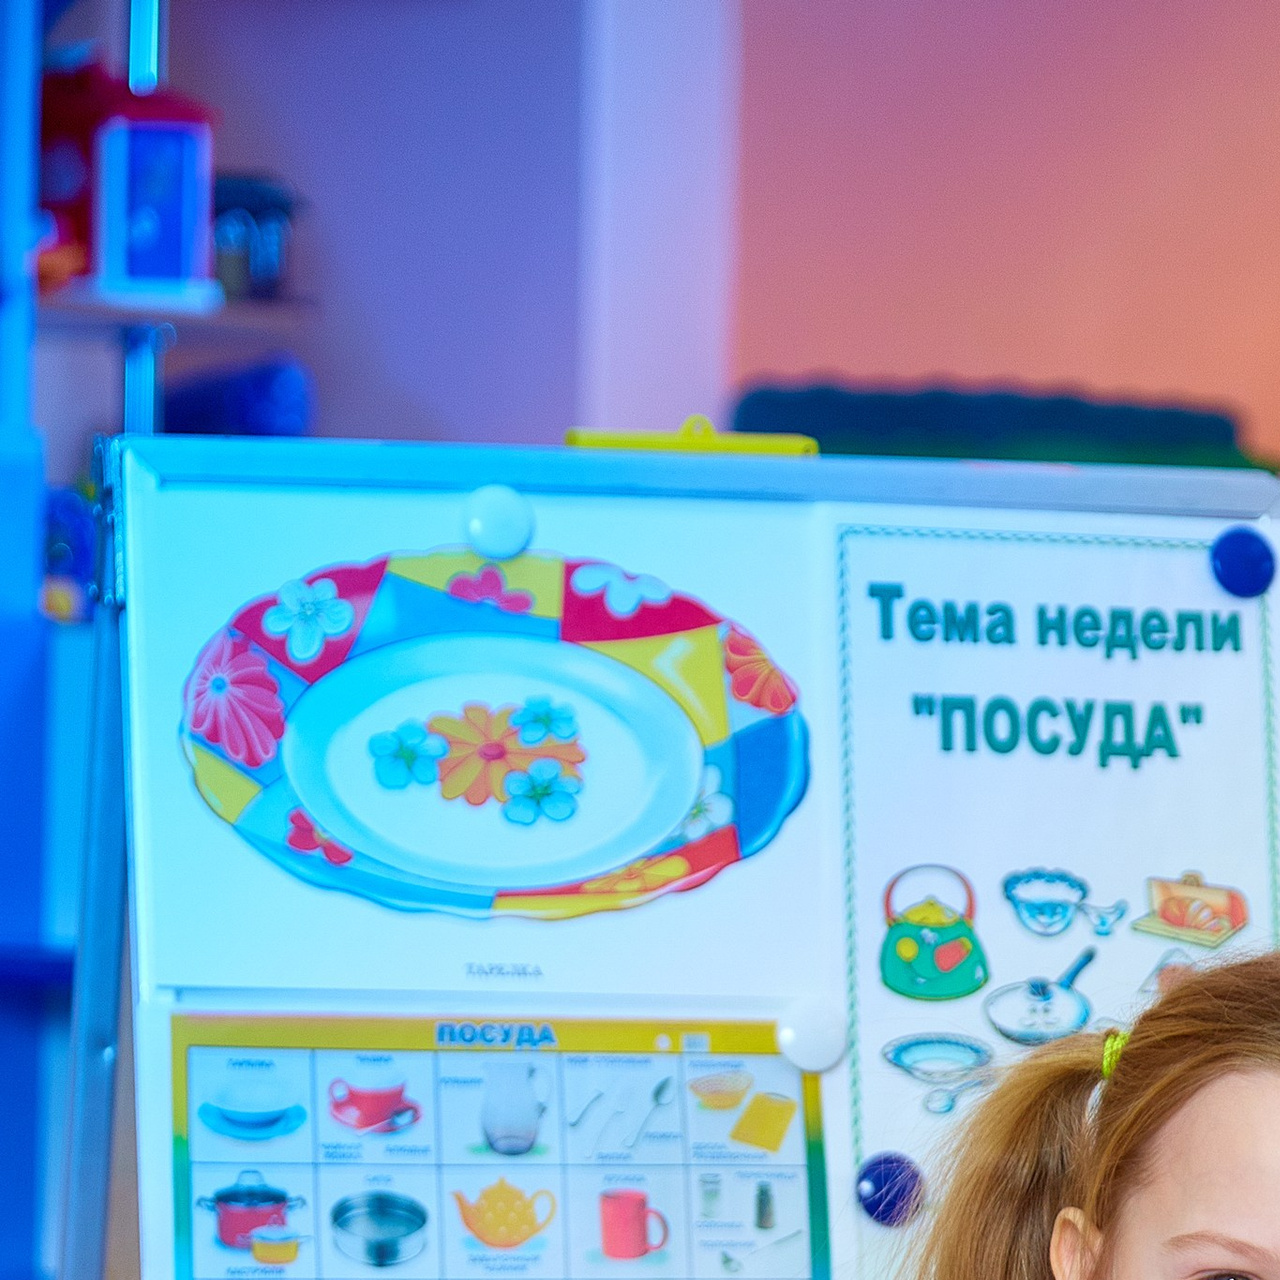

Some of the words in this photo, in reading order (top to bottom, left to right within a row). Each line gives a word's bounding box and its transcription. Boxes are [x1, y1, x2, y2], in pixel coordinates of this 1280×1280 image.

[868, 582, 1016, 645] Тема
[1036, 604, 1241, 660] недели
[911, 693, 1203, 769] "ПОСУДА"
[436, 1022, 557, 1048] ПОСУДА
